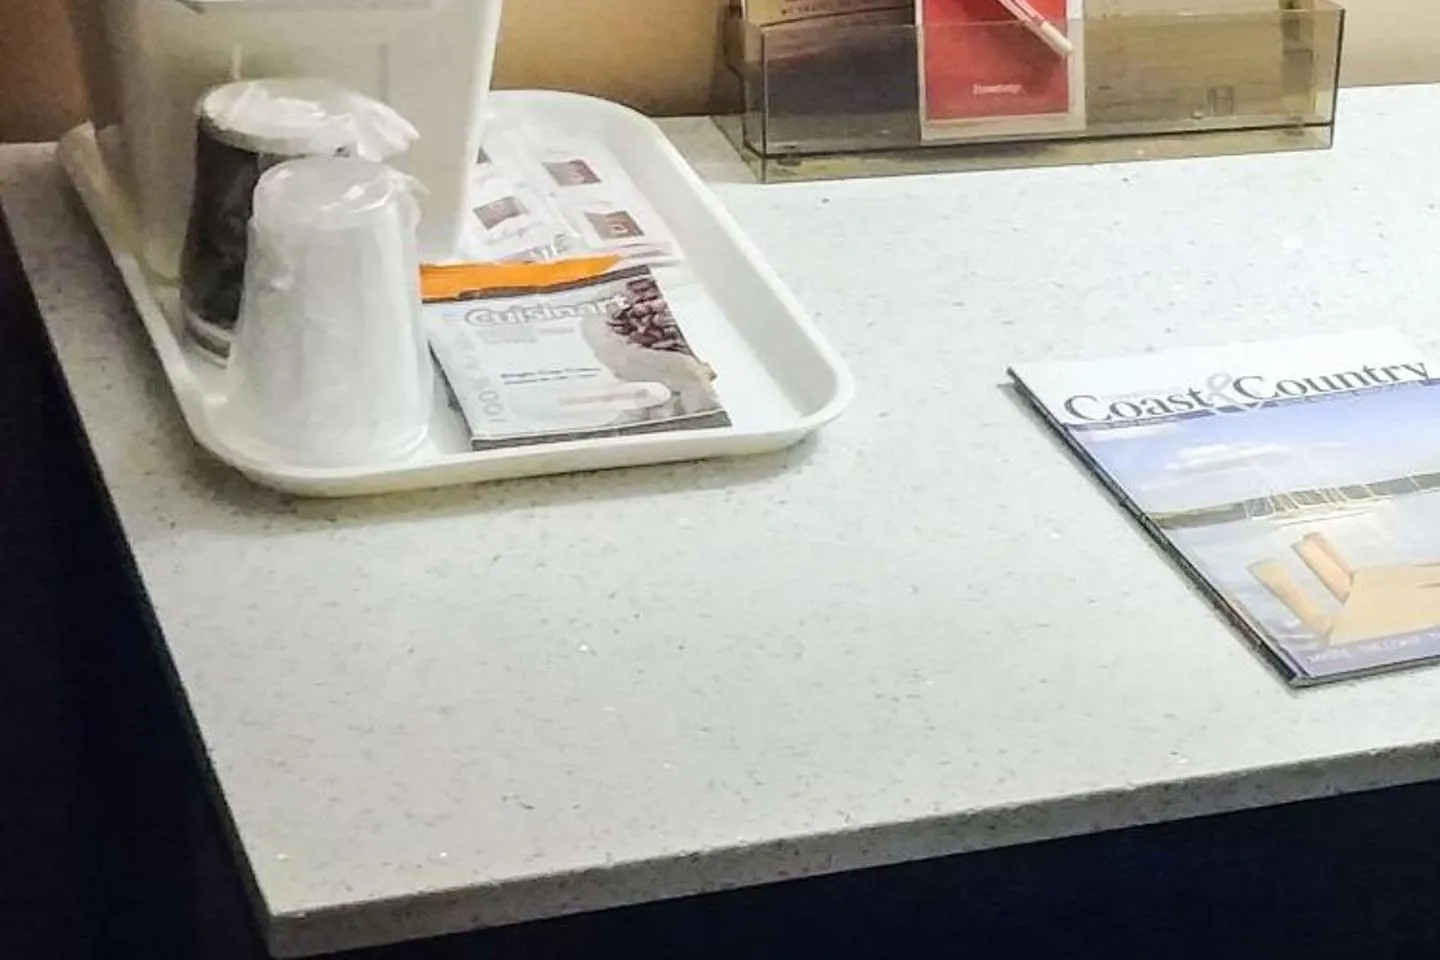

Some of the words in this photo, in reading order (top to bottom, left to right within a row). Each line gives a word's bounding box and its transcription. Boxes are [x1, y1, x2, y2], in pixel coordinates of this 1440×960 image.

[465, 296, 630, 326] Cuisinart
[1064, 386, 1214, 422] Coast
[1232, 361, 1430, 400] Country
